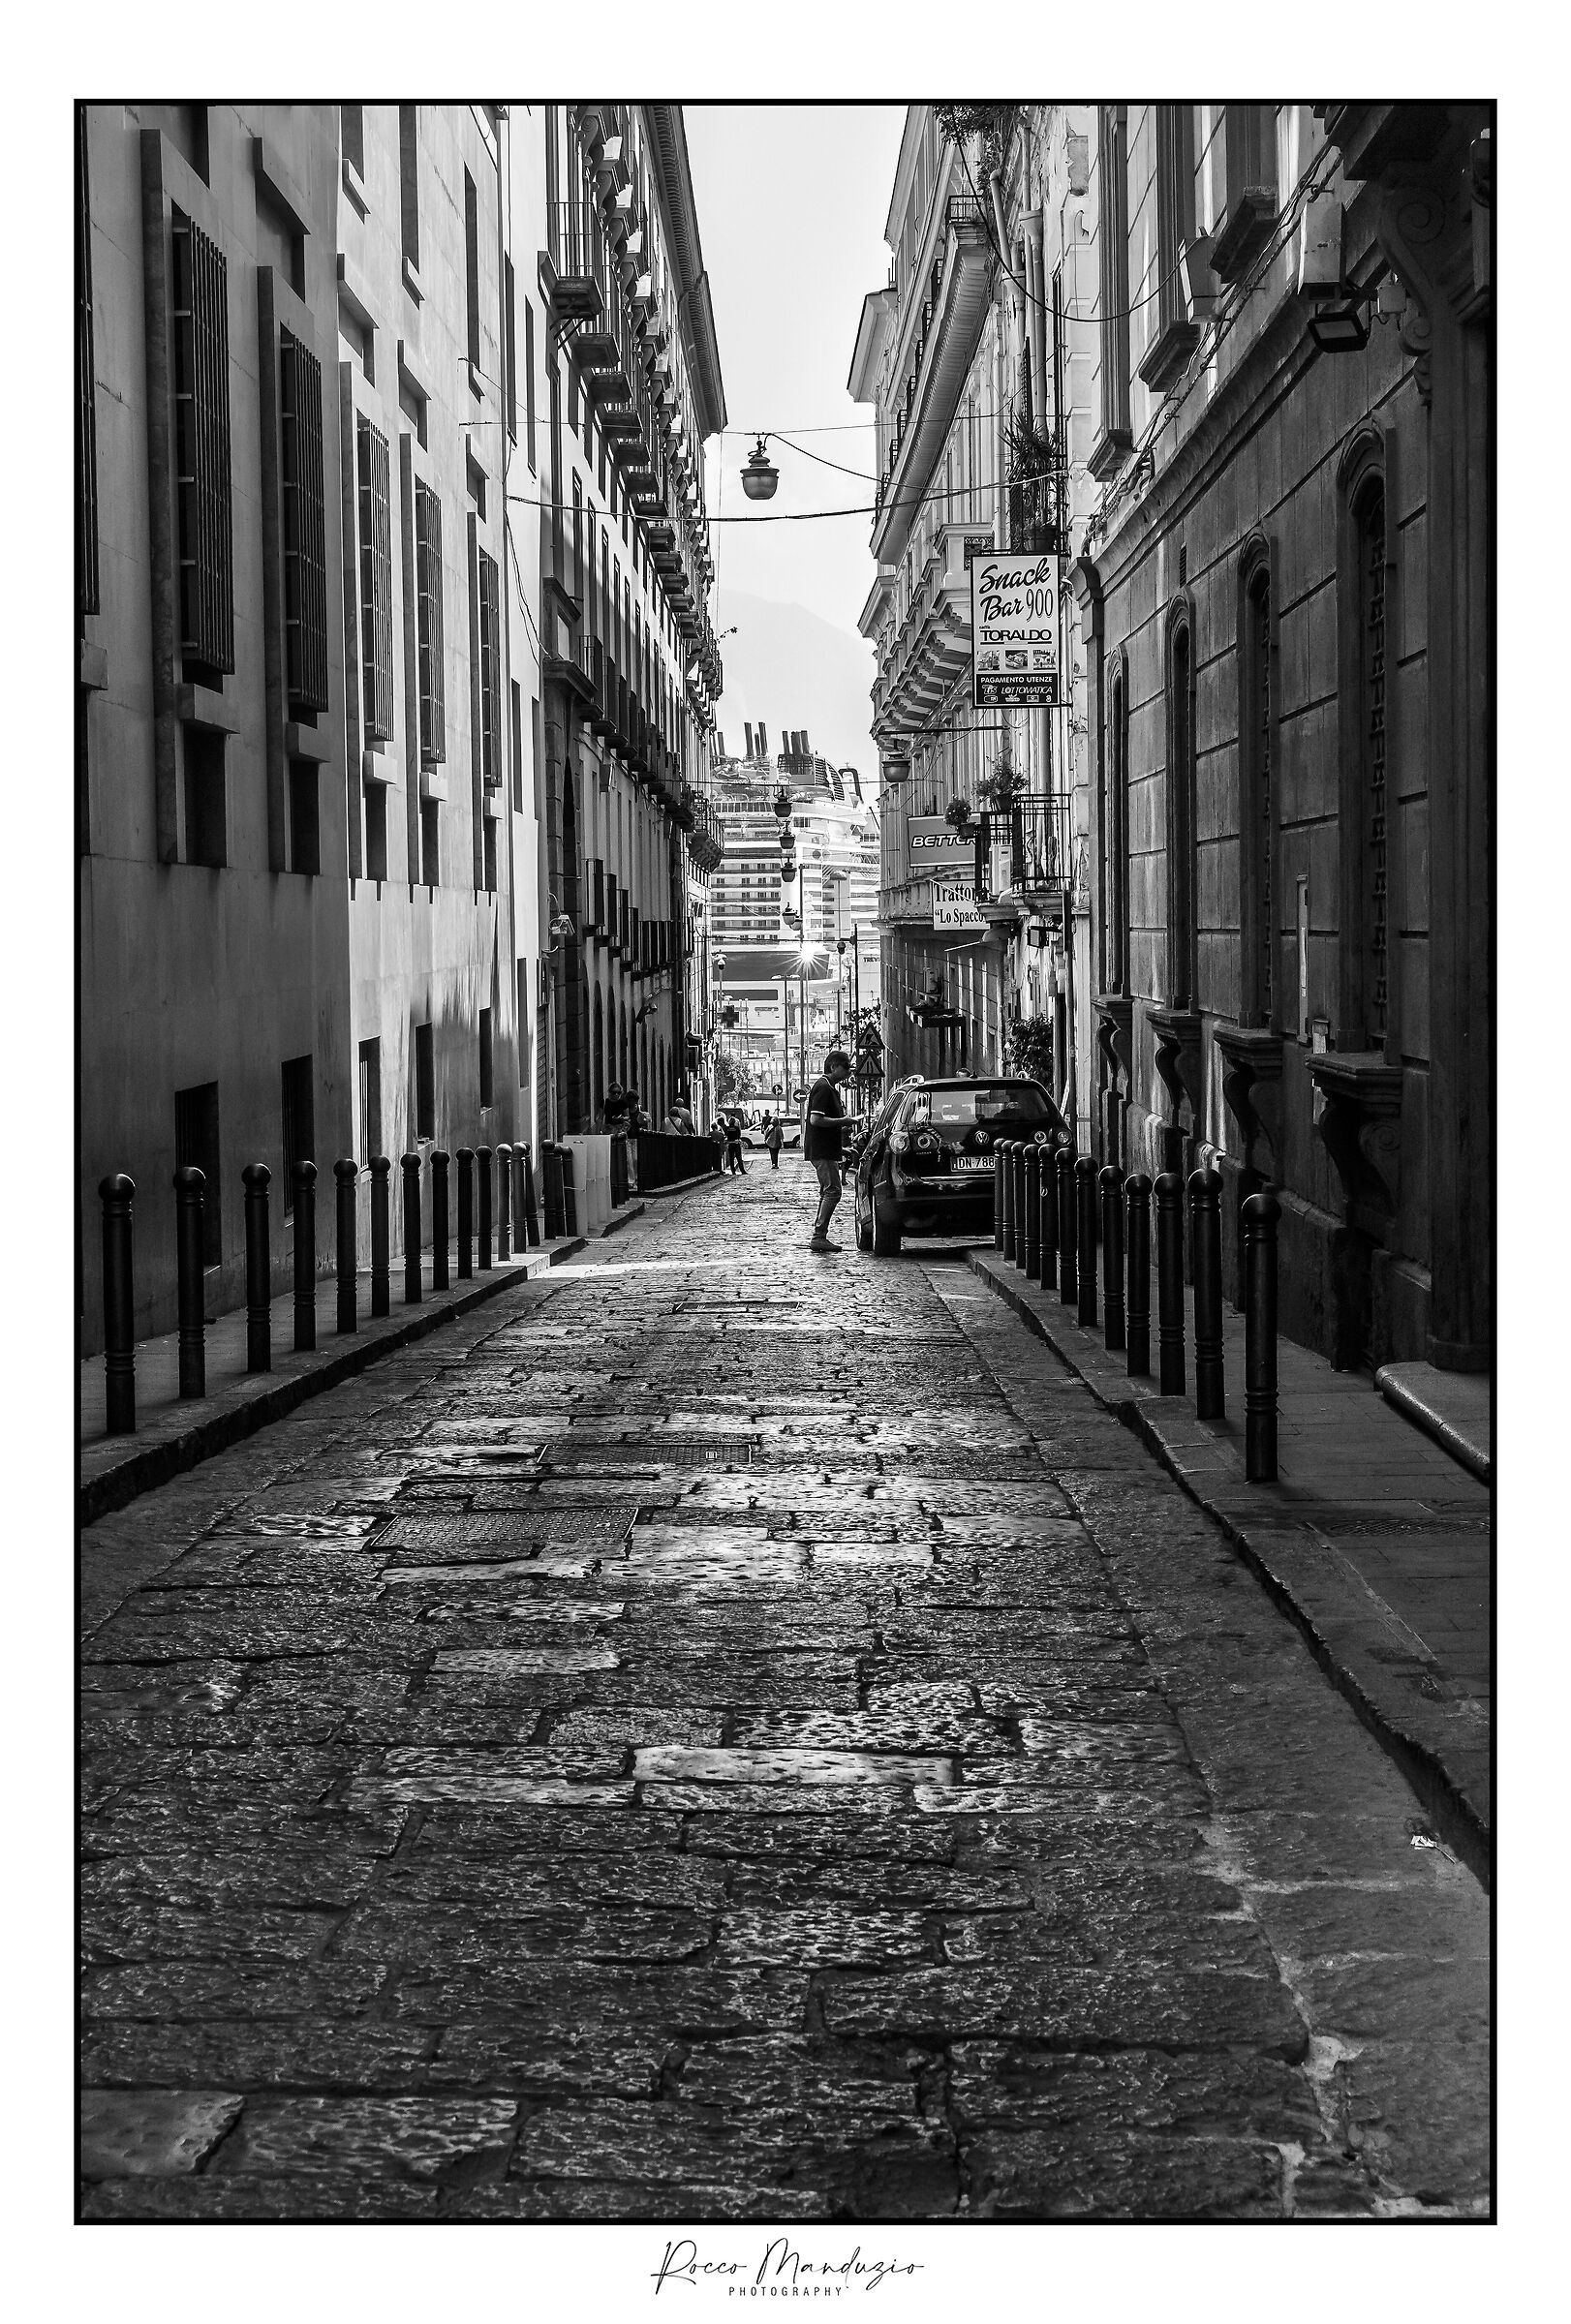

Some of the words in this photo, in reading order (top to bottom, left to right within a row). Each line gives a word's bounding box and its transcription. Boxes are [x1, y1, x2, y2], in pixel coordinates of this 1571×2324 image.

[979, 557, 1052, 594] Snack
[980, 595, 1025, 623] Bar
[1026, 588, 1054, 623] 900
[979, 629, 1052, 641] TORALDO
[1001, 686, 1053, 694] LOTTOMATICA
[958, 1156, 972, 1169] DN
